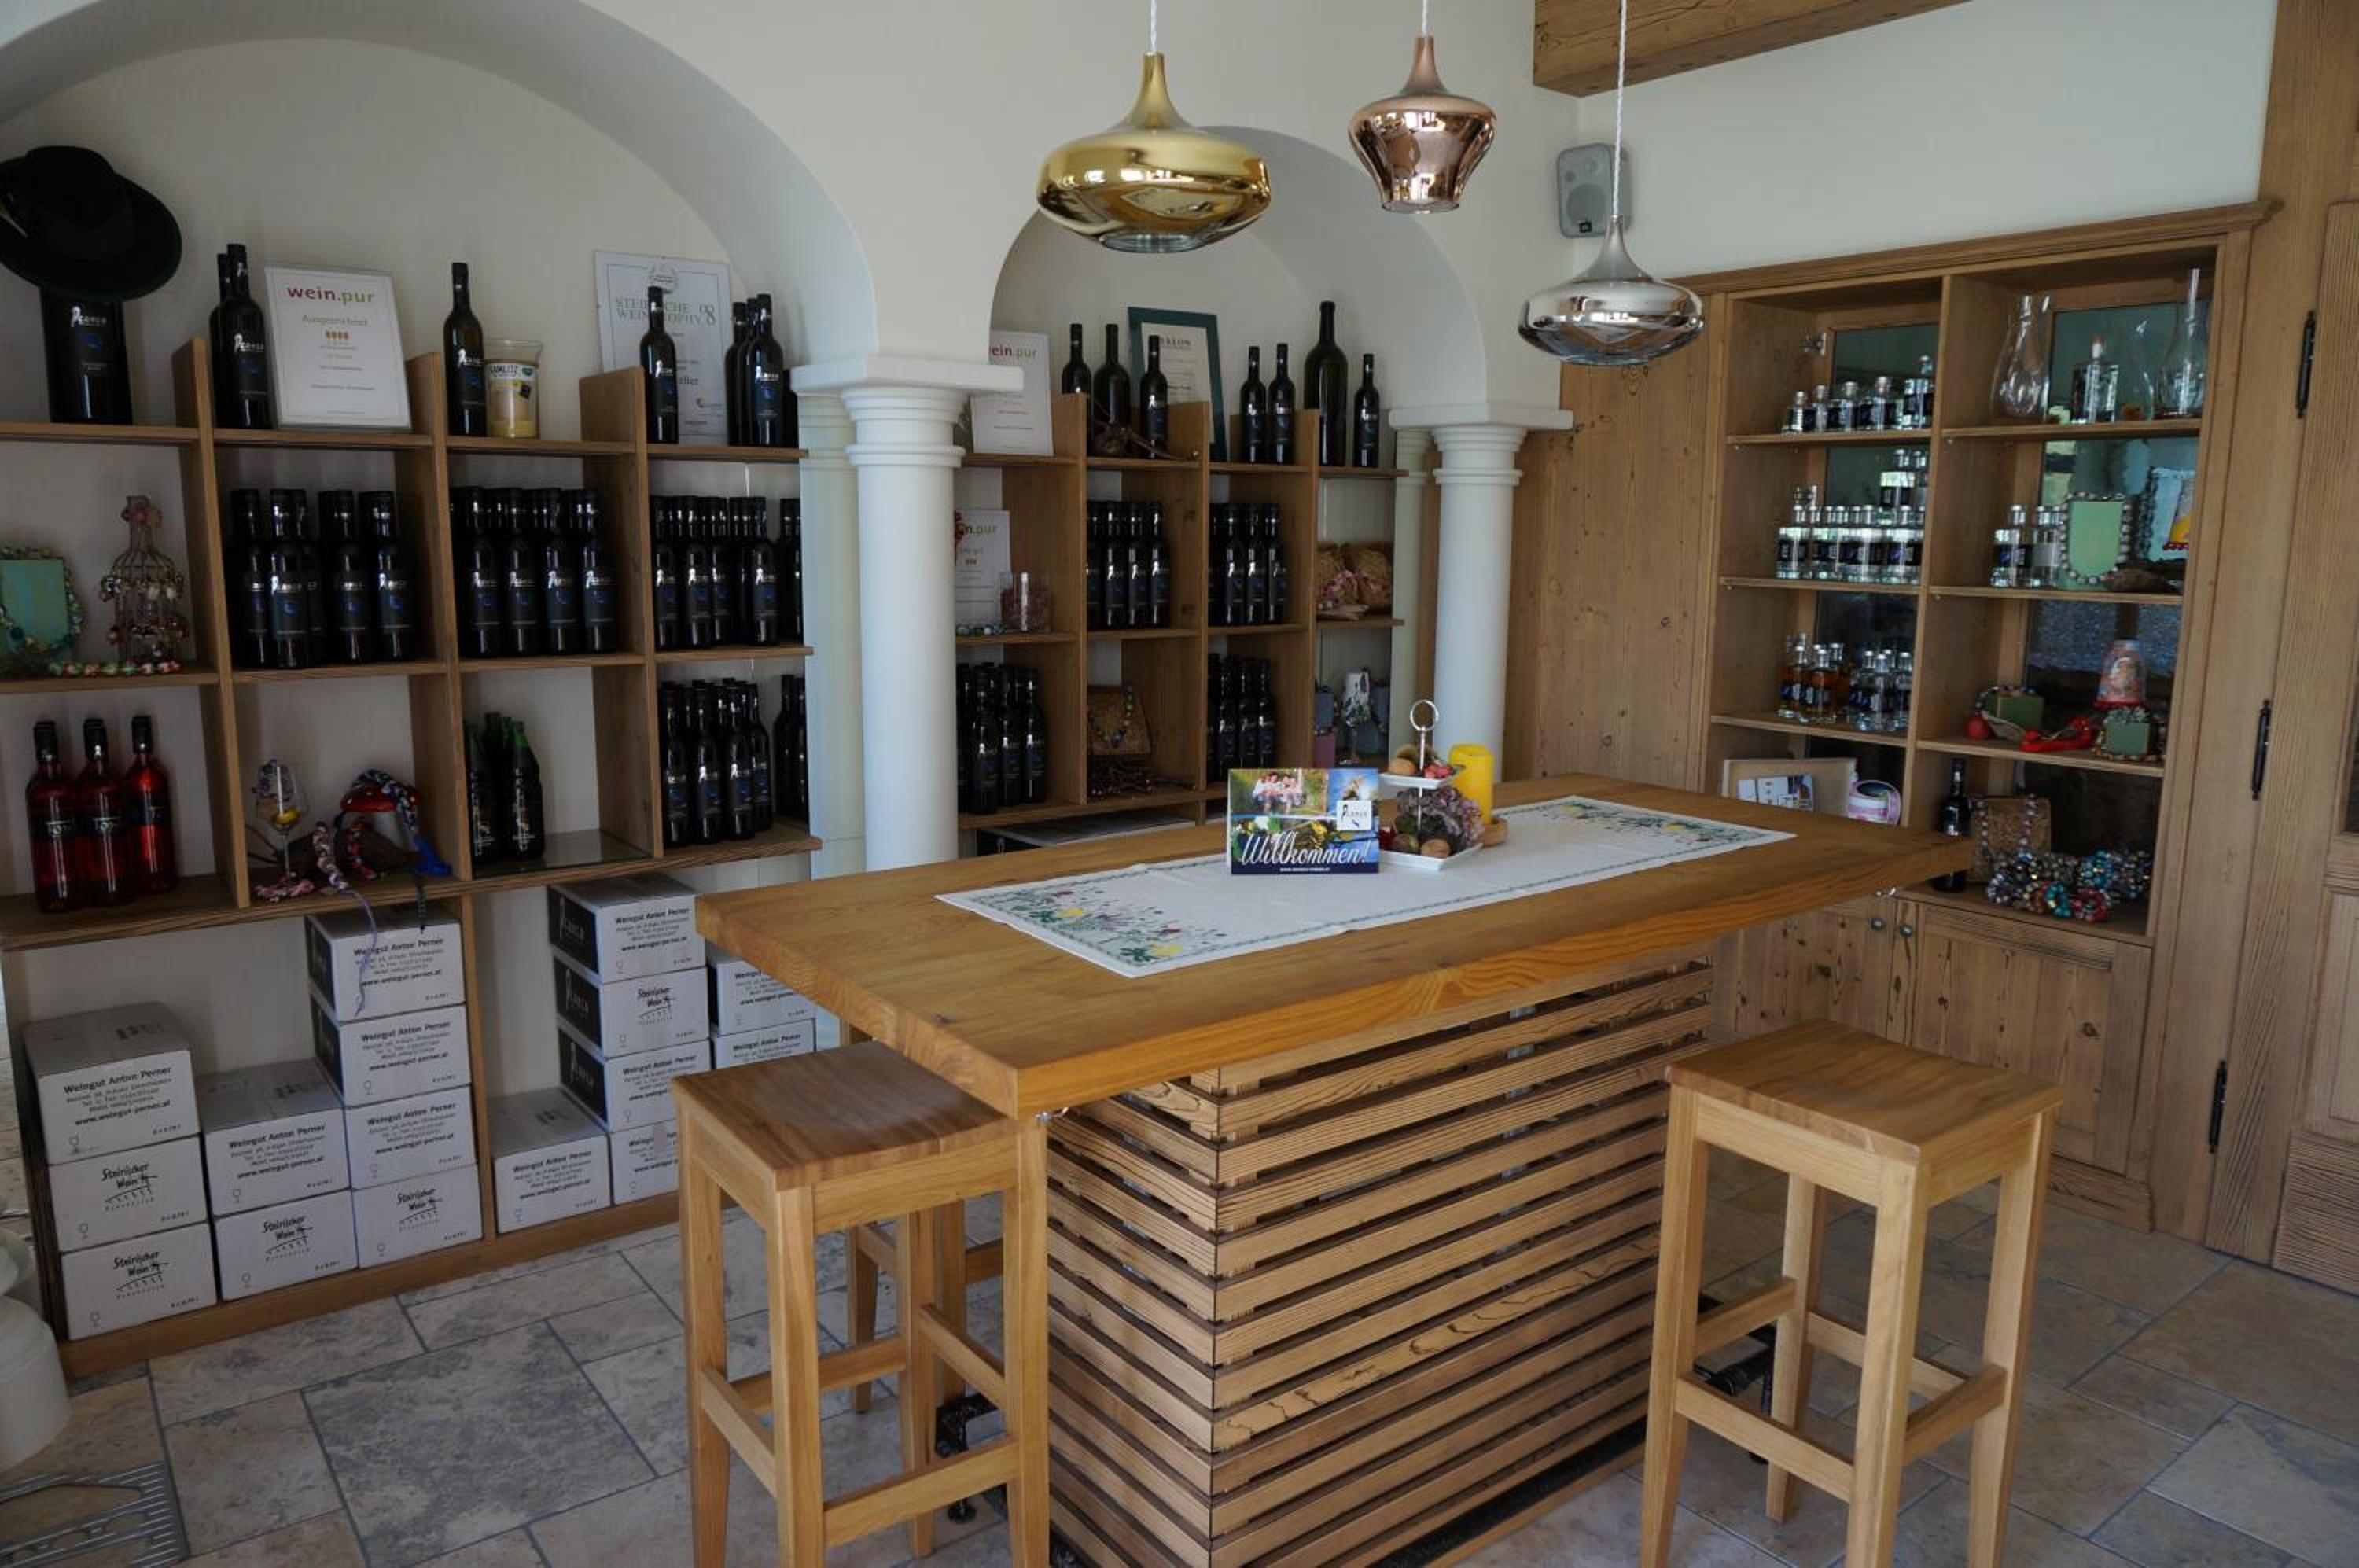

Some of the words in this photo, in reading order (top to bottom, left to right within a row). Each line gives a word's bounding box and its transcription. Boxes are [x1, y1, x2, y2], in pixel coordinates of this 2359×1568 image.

[286, 286, 375, 306] wein.pur
[991, 344, 1037, 361] ein.pur
[1240, 831, 1371, 866] Willkommen!
